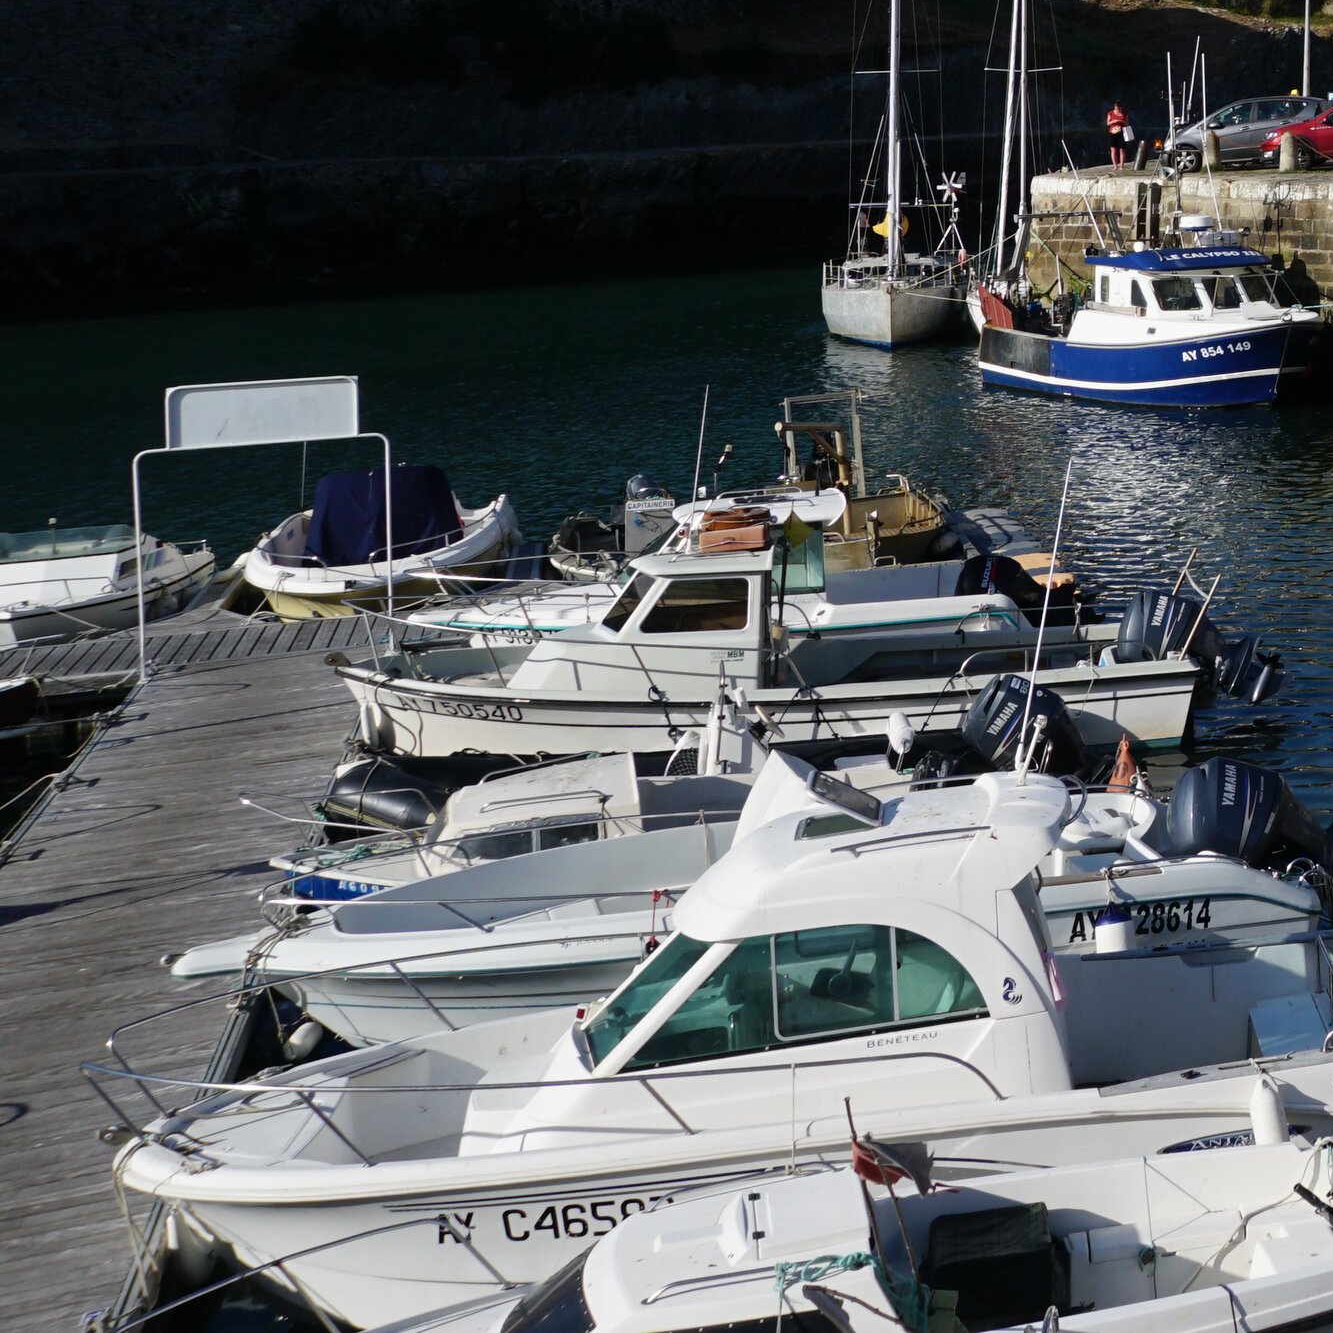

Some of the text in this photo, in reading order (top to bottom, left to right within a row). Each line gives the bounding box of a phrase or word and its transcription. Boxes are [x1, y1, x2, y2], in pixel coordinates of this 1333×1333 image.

[1163, 253, 1181, 261] LE
[1182, 250, 1240, 259] CALYPSO
[1181, 341, 1251, 363] AY 854 149
[1150, 595, 1169, 626] YAMAHA
[727, 649, 745, 659] MBM
[422, 699, 524, 722] 750540
[986, 701, 1019, 736] YAMAHA
[1221, 764, 1238, 806] YAMAHA
[1128, 897, 1212, 936] 28614
